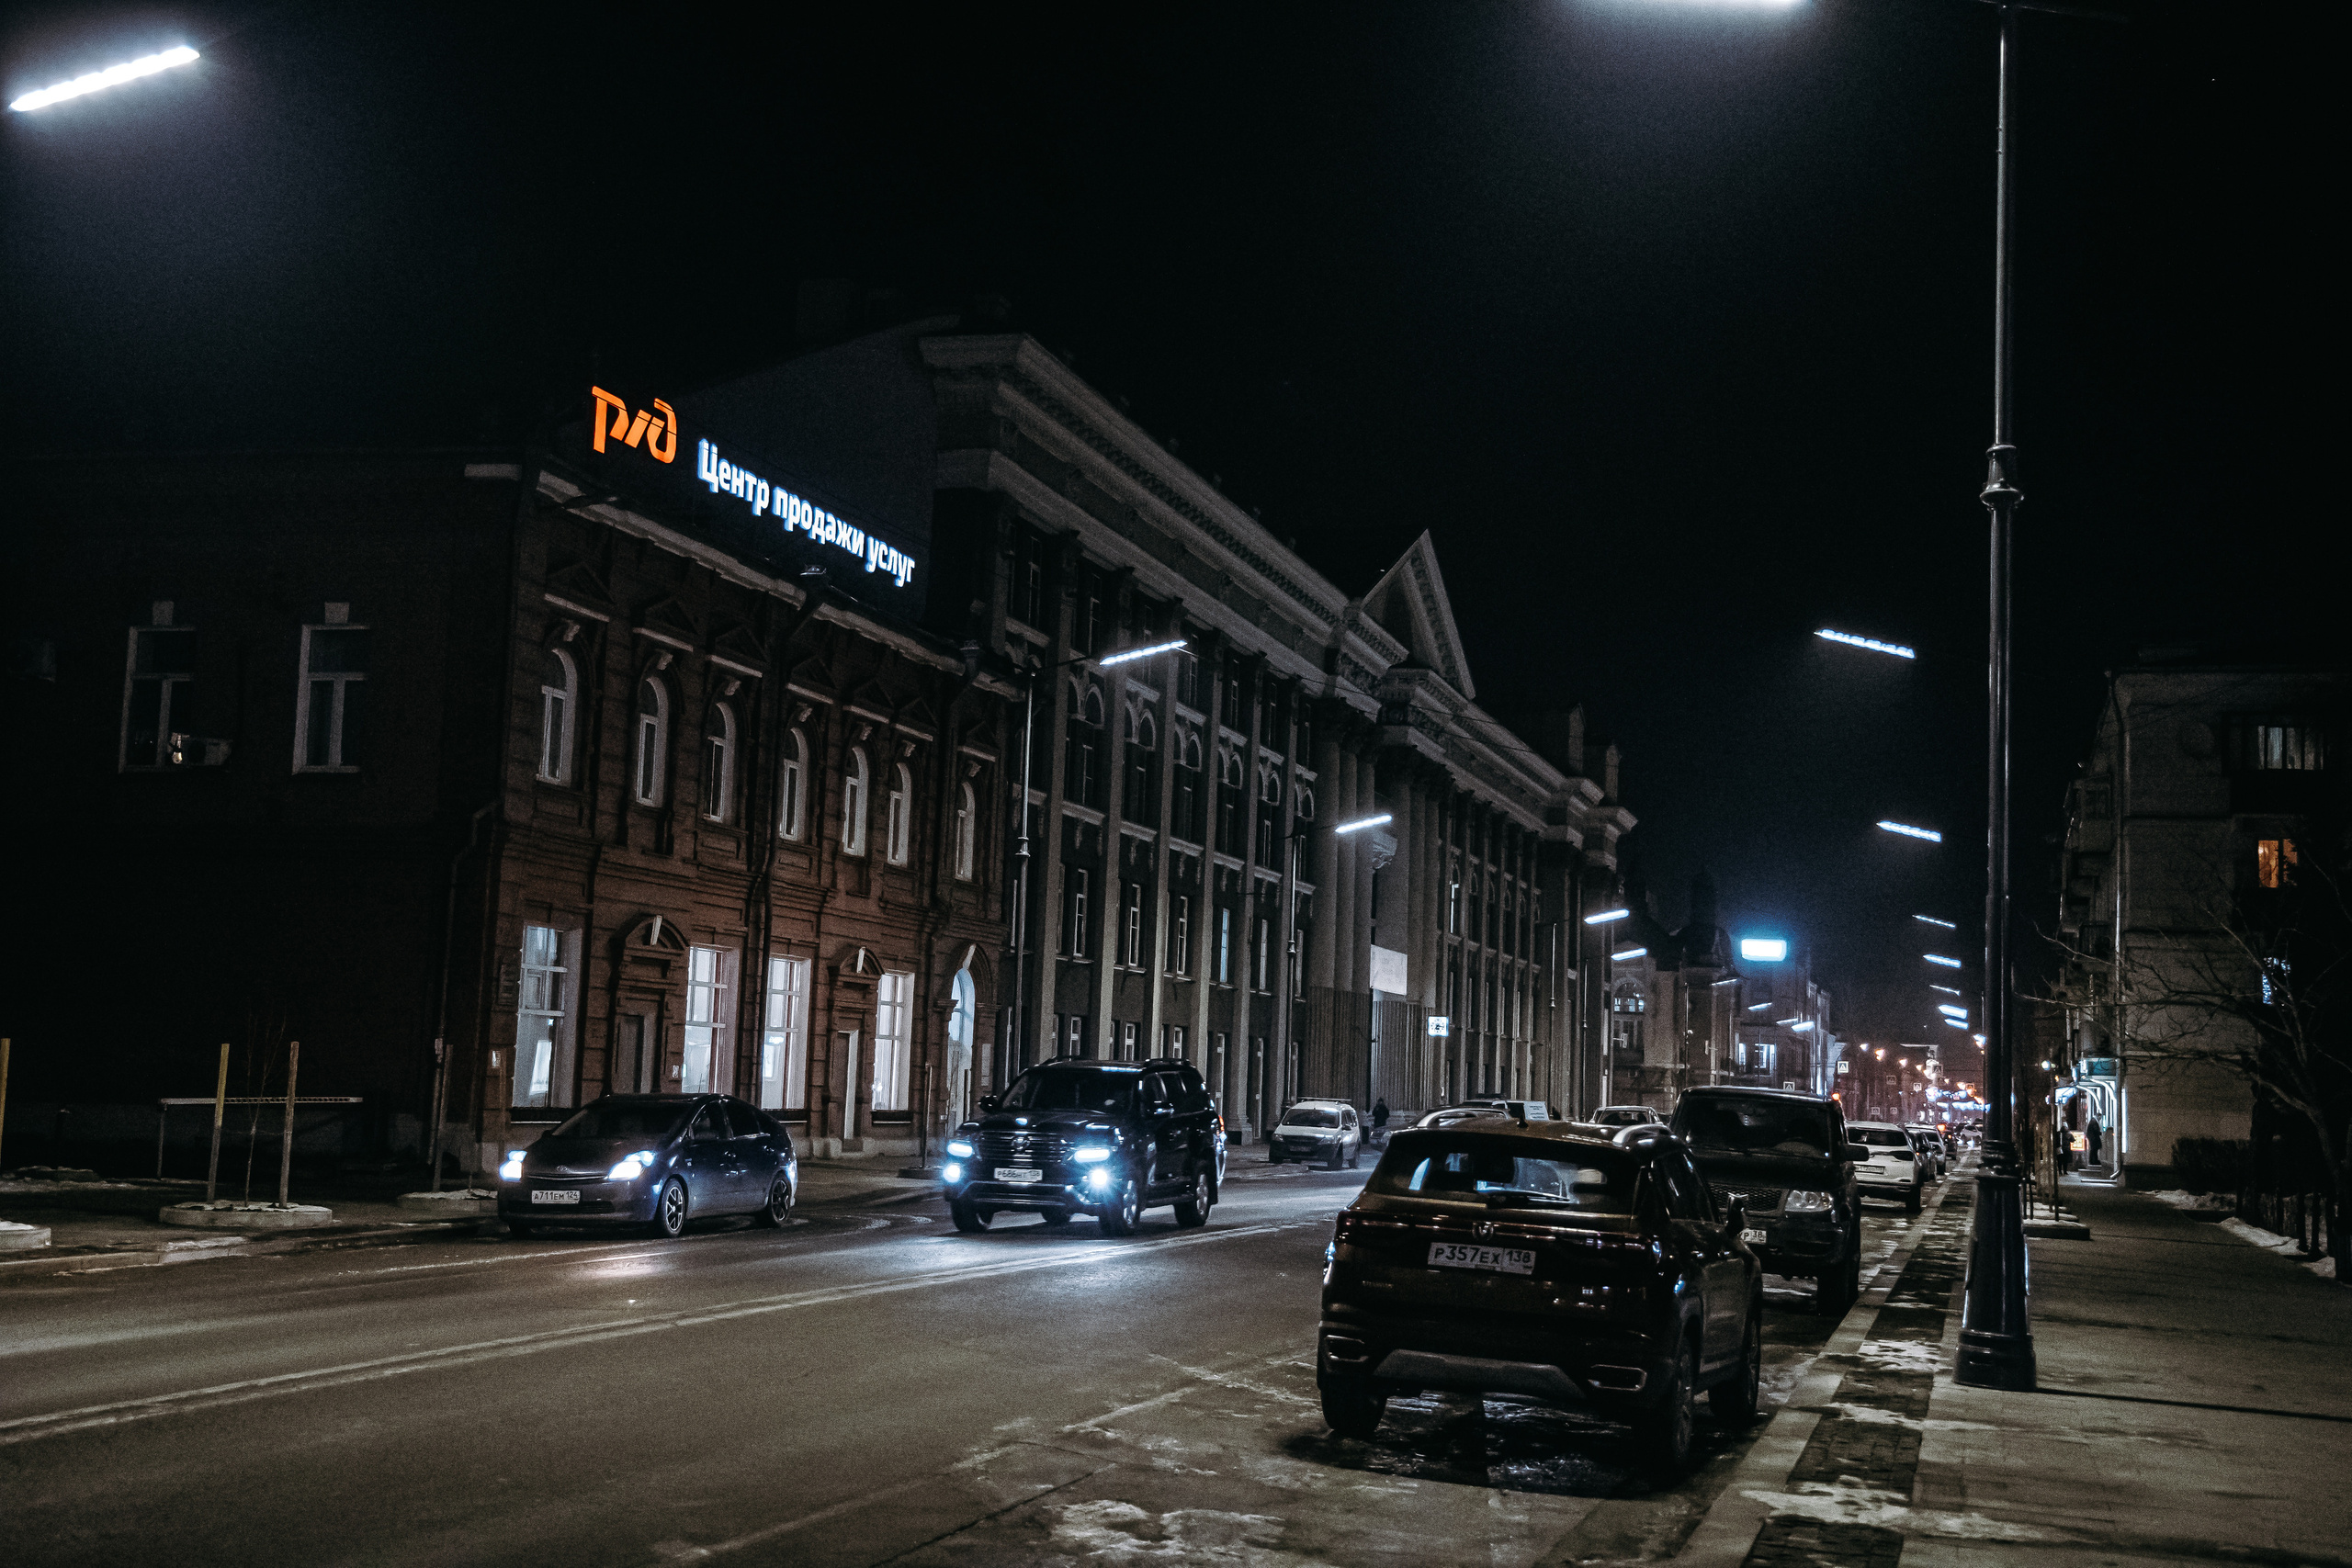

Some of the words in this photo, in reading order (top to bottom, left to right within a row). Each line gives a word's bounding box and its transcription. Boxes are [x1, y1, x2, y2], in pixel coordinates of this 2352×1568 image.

[697, 438, 770, 516] Центр
[773, 486, 865, 558] продажи
[865, 536, 916, 587] услуг
[534, 1191, 564, 1201] А711ЕМ
[1434, 1245, 1500, 1265] Р357ЕХ
[1506, 1249, 1532, 1263] 138
